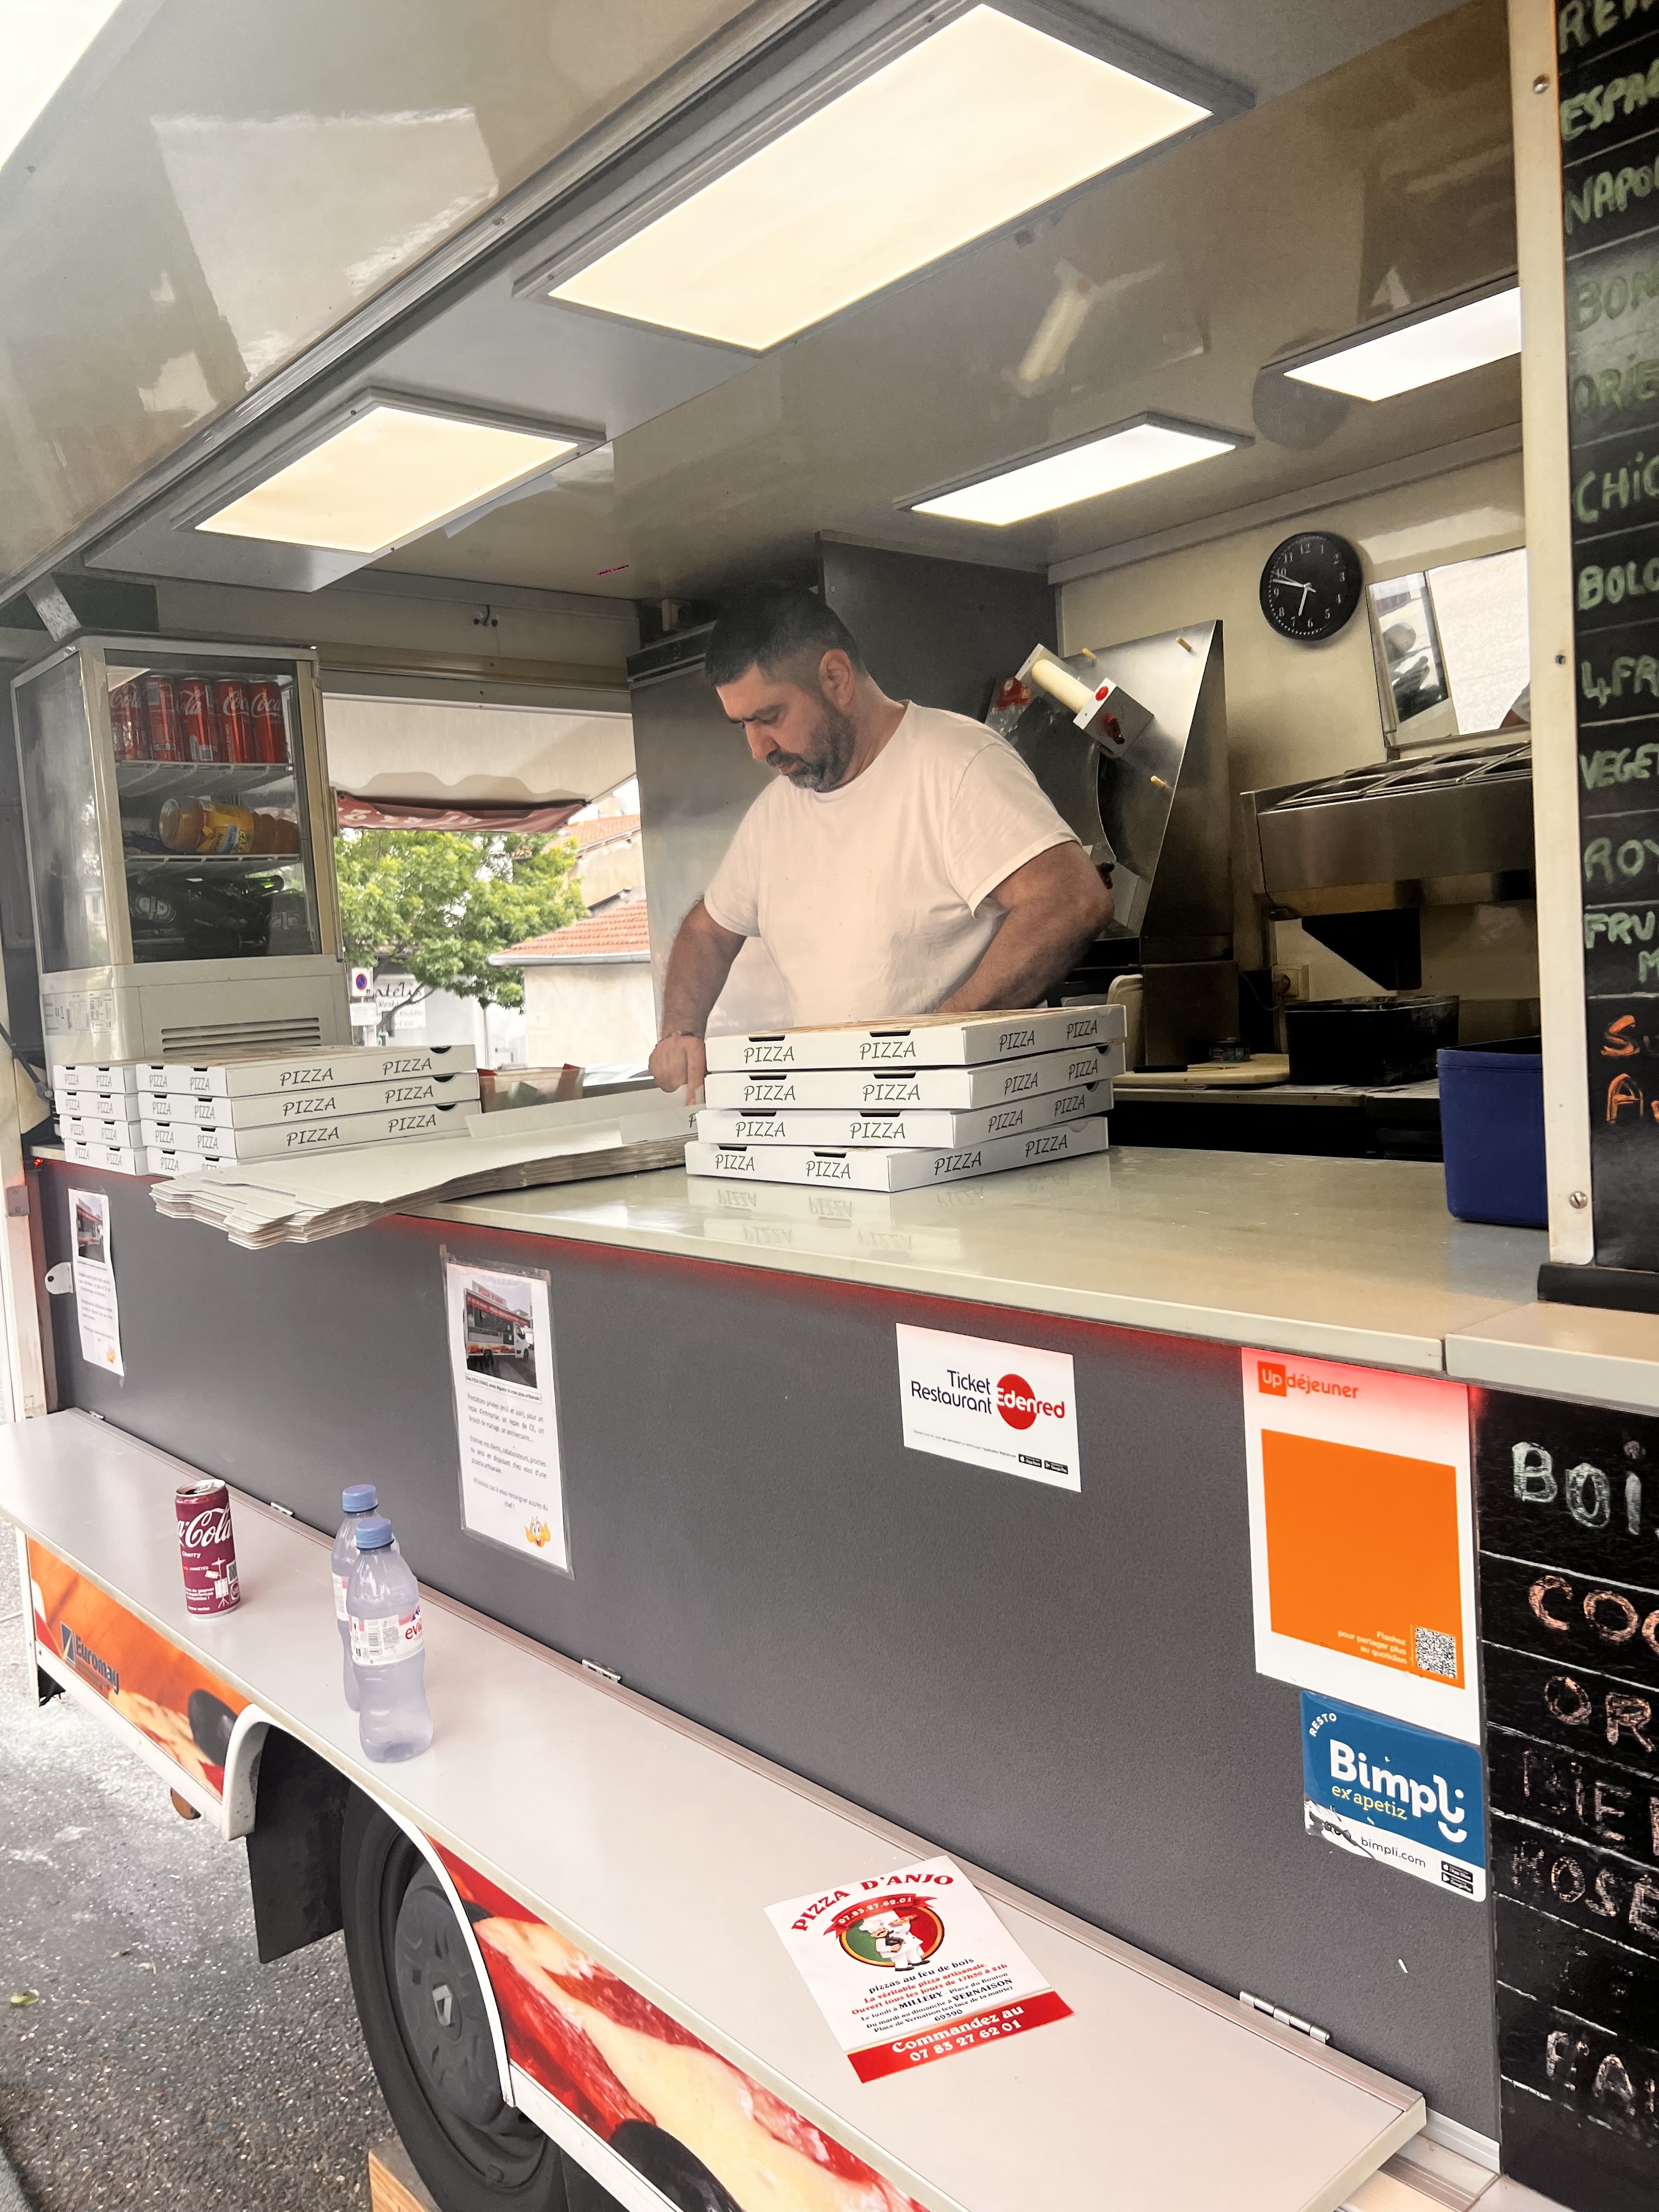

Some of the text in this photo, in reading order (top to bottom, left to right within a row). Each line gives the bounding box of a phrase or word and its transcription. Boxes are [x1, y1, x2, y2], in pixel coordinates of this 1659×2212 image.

[1284, 552, 1293, 563] 11
[1300, 543, 1311, 555] 12
[1334, 554, 1339, 564] 2
[1274, 588, 1279, 597] 9
[1279, 607, 1285, 617] 8
[1290, 616, 1296, 626] 7
[1308, 617, 1313, 628] 6
[1325, 608, 1330, 619] 5
[999, 1019, 1097, 1052] PIZZA PIZZA
[744, 1041, 916, 1064] PIZZA PIZZA
[65, 1074, 112, 1087] PIZZA PIZZA
[149, 1075, 210, 1091] PIZZA PIZZA
[280, 1058, 432, 1086] PIZZA PIZZA
[1004, 1059, 1098, 1095] PIZZA PIZZA
[283, 1086, 433, 1116] PIZZA PIZZA
[744, 1084, 920, 1101] PIZZA PIZZA
[66, 1099, 113, 1114] PIZZA PIZZA
[153, 1102, 215, 1119] PIZZA PIZZA
[989, 1094, 1085, 1133] PIZZA PIZZA
[71, 1124, 117, 1141] PIZZA PIZZA
[155, 1130, 218, 1149] PIZZA PIZZA
[286, 1114, 436, 1146] PIZZA PIZZA
[736, 1121, 905, 1139] PIZZA PIZZA
[75, 1148, 122, 1166] PIZZA PIZZA
[161, 1161, 179, 1171] PIZZA
[715, 1154, 851, 1179] PIZZA PIZZA
[934, 1135, 1068, 1176] PIZZA PIZZA
[947, 1369, 991, 1395] Ticket
[1261, 1368, 1359, 1399] Up déjeuner
[911, 1380, 992, 1414] Restaurant
[996, 1387, 1065, 1418] Edenred
[1338, 1630, 1407, 1655] pour partager plus
[1377, 1631, 1407, 1646] Flashez
[1372, 1649, 1407, 1664] quotidien
[1309, 1712, 1338, 1737] RESTO
[1329, 1739, 1465, 1823] Bimpli
[1331, 1785, 1408, 1820] ex apetiz
[1361, 1836, 1426, 1868] bimpli.com
[791, 1874, 953, 1931] PIZZA D'ANJO
[838, 1897, 911, 1923] 07.83.27.62.01
[869, 1980, 901, 1994] pizzas
[918, 1970, 935, 1978] feu
[952, 1959, 974, 1968] bois
[878, 1984, 916, 1999] véritable
[918, 1977, 940, 1988] pizza
[851, 2002, 882, 2015] Ouvert
[885, 1996, 904, 2005] tous
[922, 1984, 944, 1994] jours
[872, 2008, 891, 2018] lundi
[899, 1991, 943, 2009] MILLERY
[949, 1985, 969, 1994] Place
[879, 2016, 900, 2025] mardi
[912, 2002, 946, 2015] dimanche
[952, 1978, 1012, 2001] VERNAISON
[905, 2009, 941, 2023] Vernaison
[988, 1986, 1013, 1996] mairie)
[934, 2010, 963, 2021] 69390
[892, 2006, 1024, 2053] Commandez au
[910, 2019, 1022, 2061] 07 83 27 62 01
